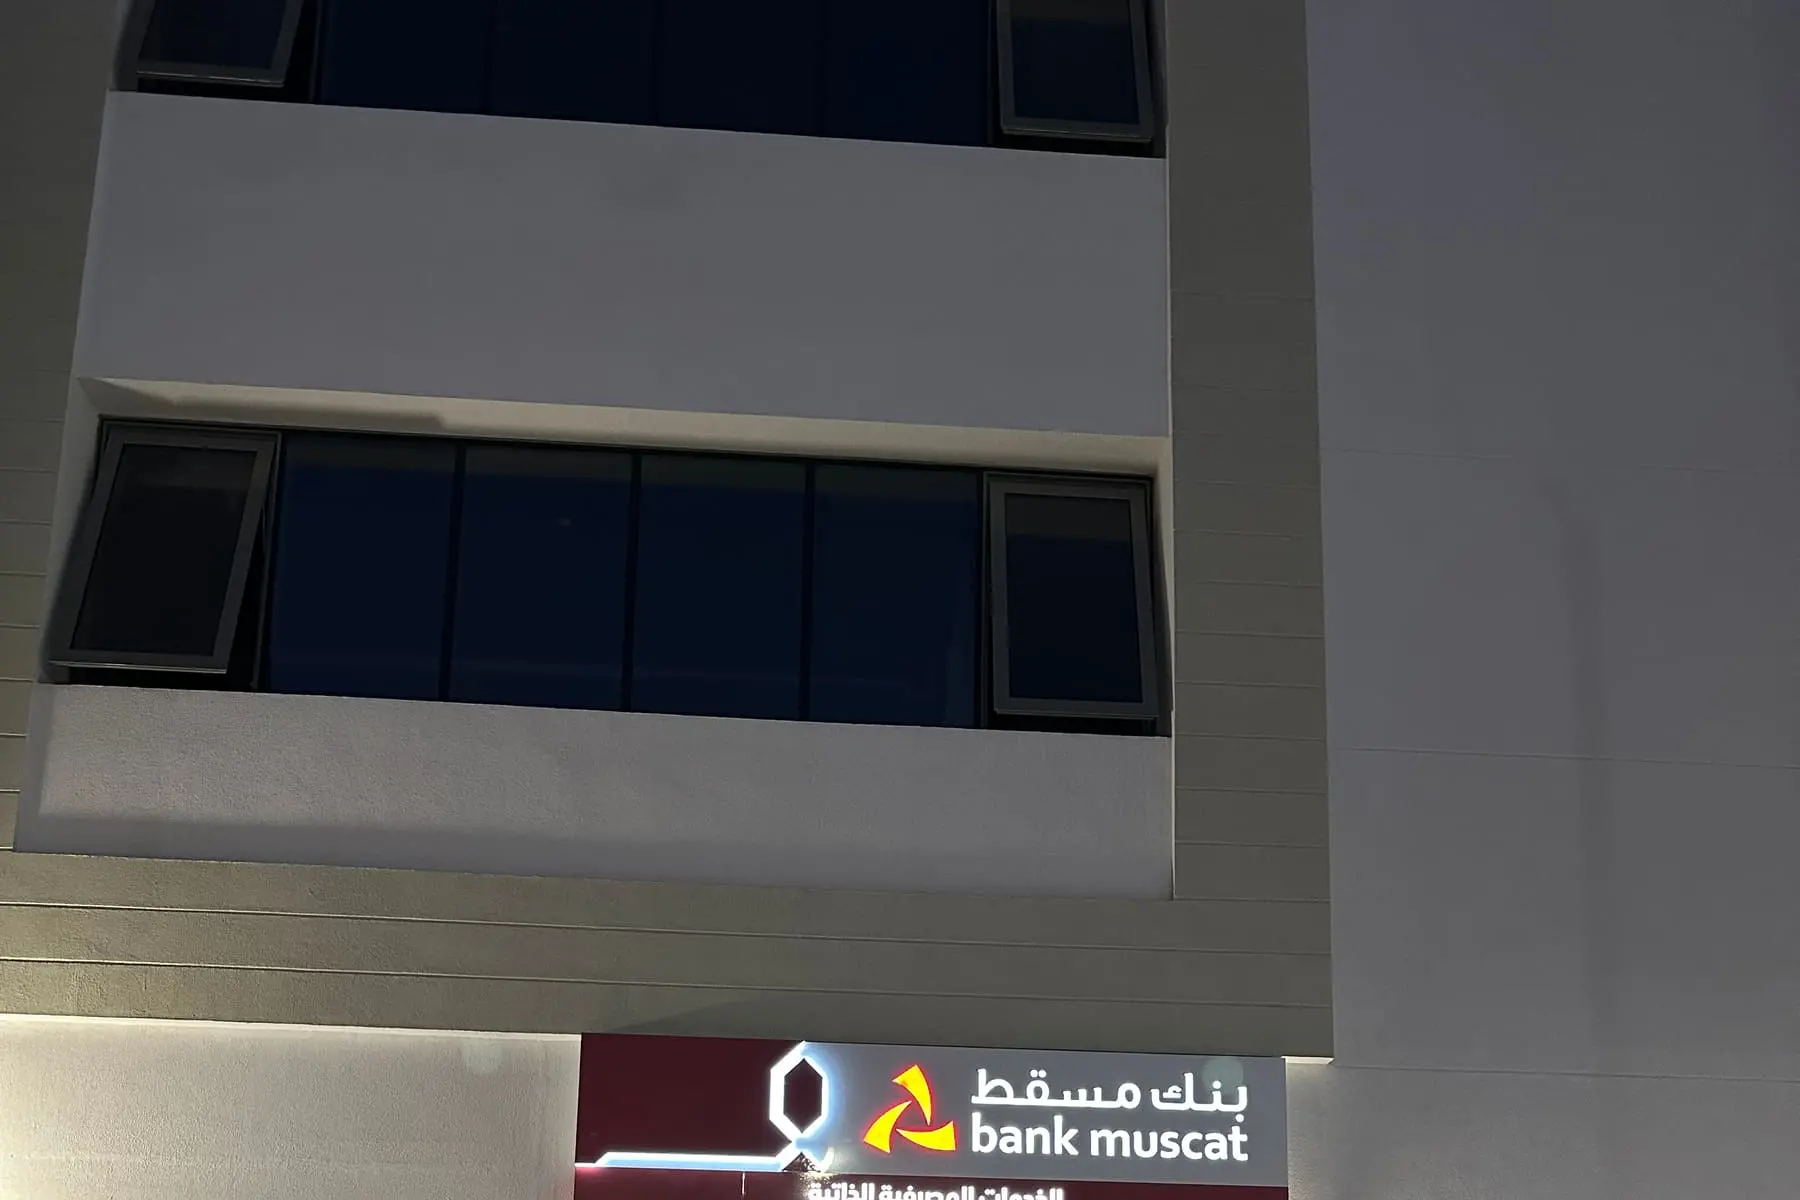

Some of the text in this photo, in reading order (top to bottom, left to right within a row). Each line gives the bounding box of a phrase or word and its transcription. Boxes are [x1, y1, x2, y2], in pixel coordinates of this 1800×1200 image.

[971, 1068, 1248, 1123] بنك مسقط
[971, 1112, 1249, 1161] bank muscat
